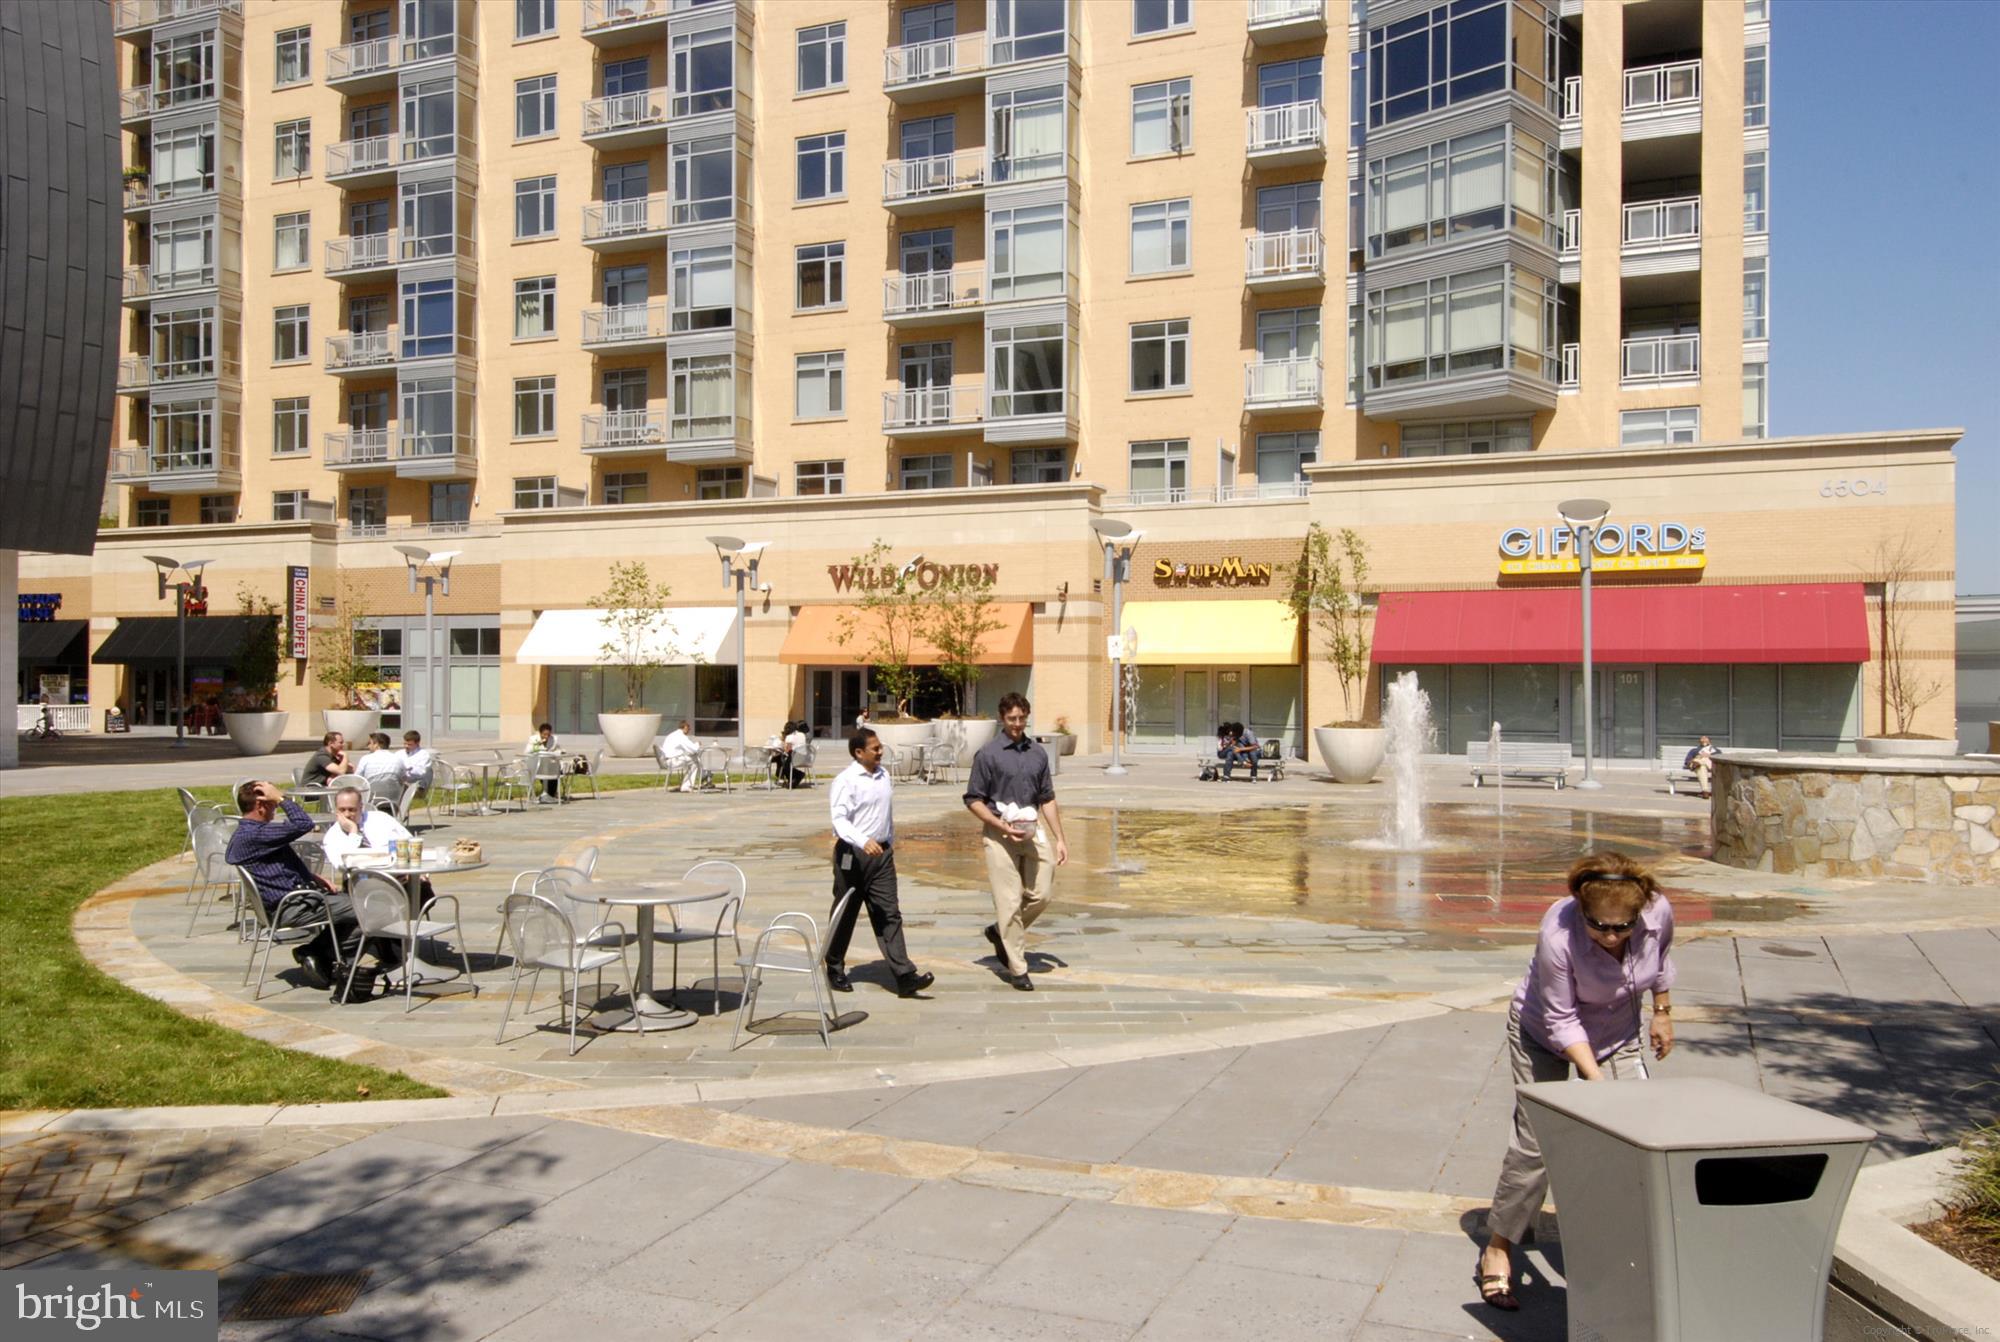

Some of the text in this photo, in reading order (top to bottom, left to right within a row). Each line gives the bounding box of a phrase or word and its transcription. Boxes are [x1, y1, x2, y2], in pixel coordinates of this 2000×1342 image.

[1820, 479, 1887, 498] 6504
[295, 579, 306, 611] CHINA
[295, 616, 306, 656] BUFFET
[1222, 673, 1237, 682] 102
[1620, 673, 1638, 684] 101
